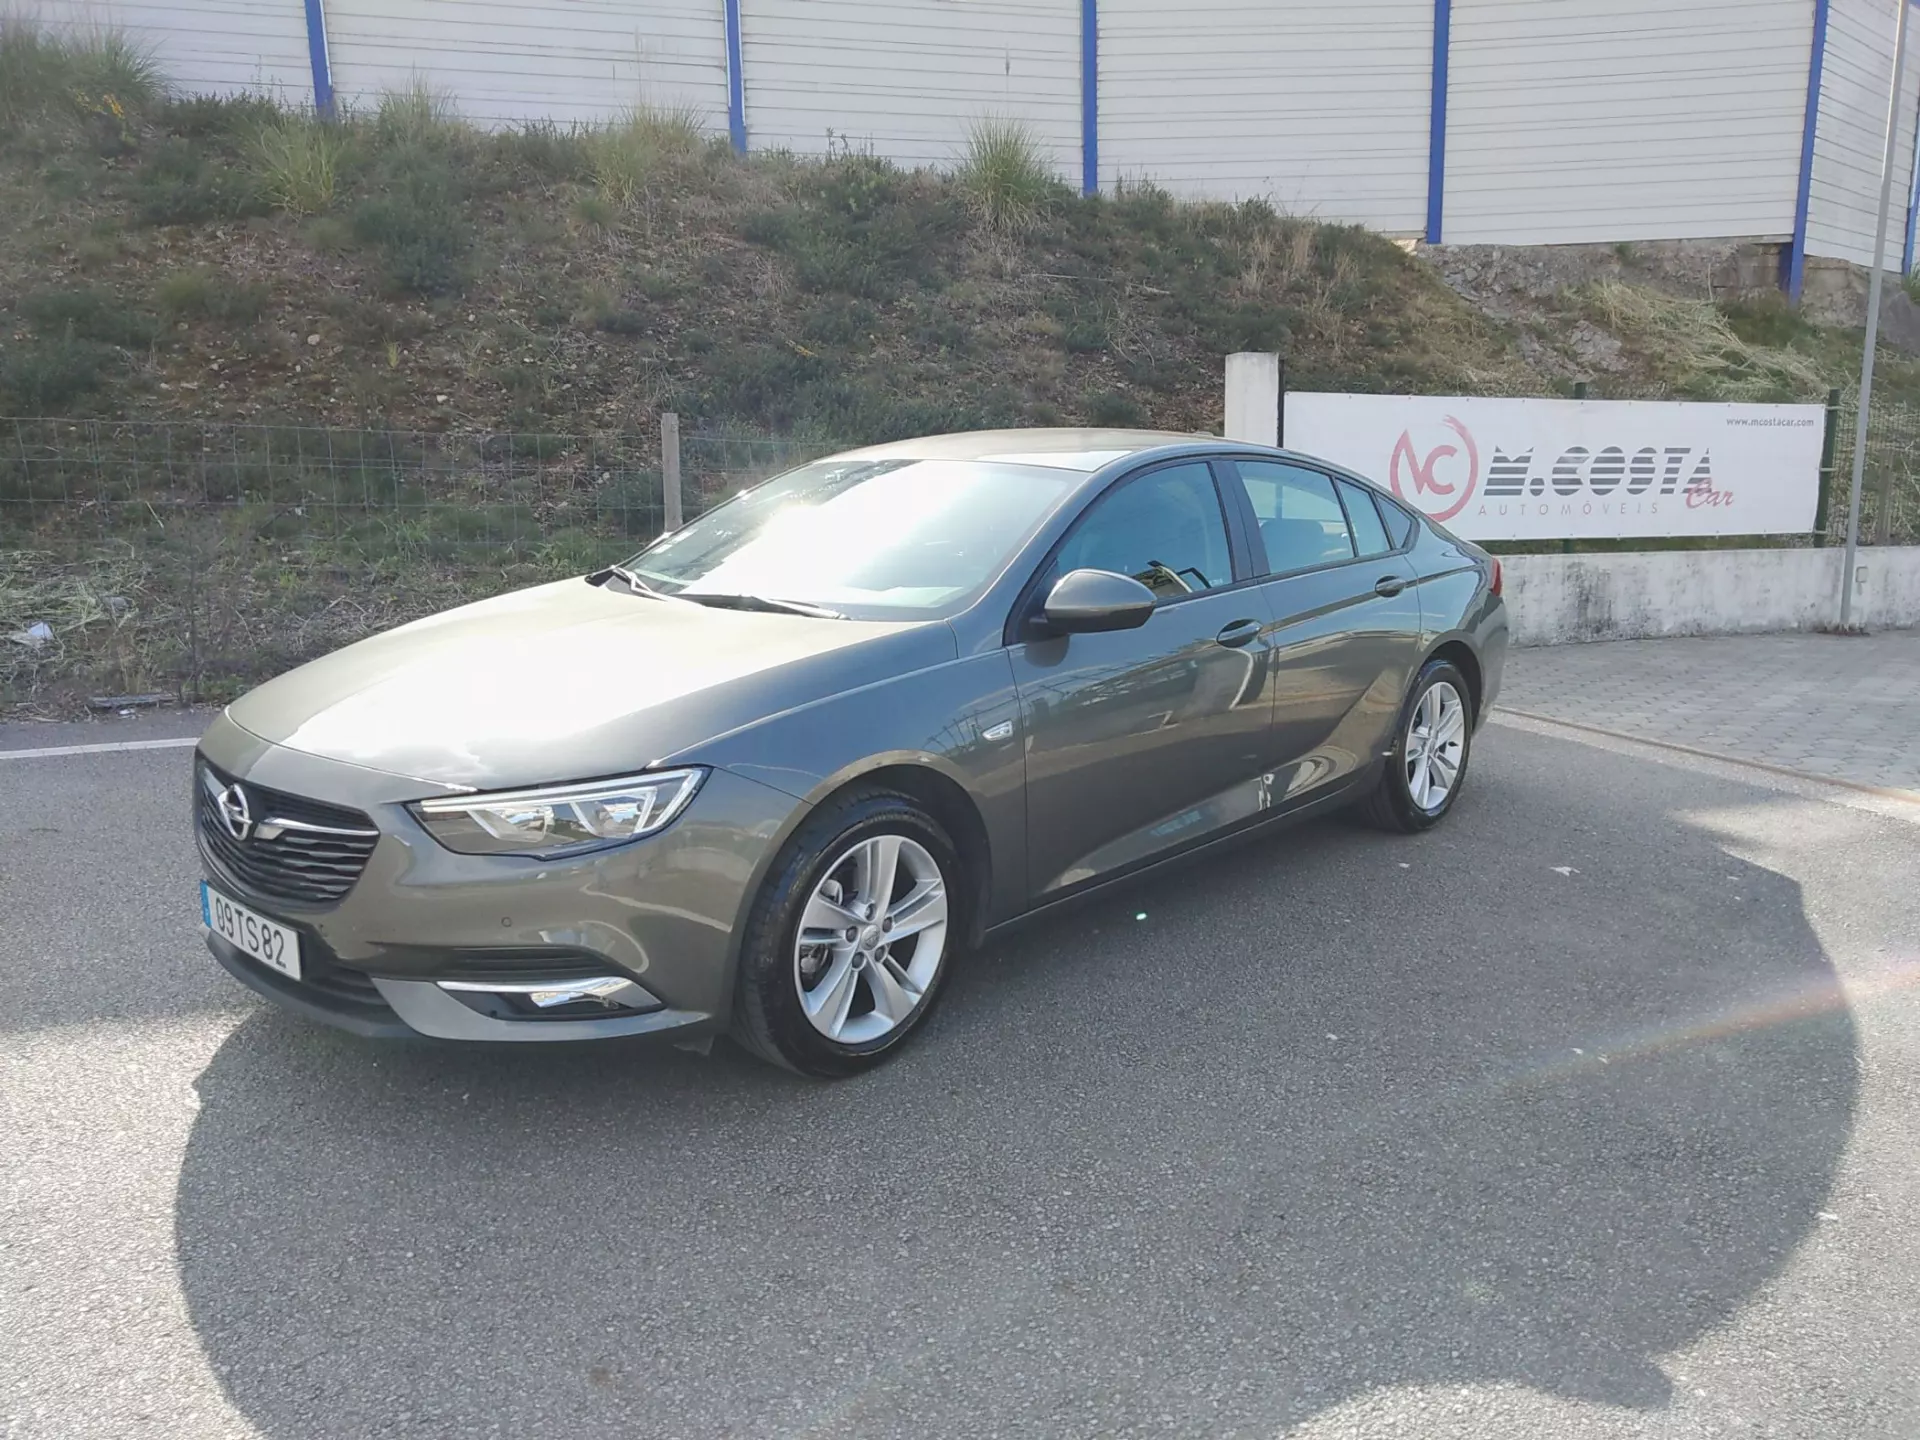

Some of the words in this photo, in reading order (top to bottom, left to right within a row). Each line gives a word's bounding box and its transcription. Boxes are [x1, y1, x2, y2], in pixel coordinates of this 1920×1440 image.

[1726, 417, 1815, 428] www.mcostacar.com
[1685, 477, 1735, 509] Car
[1477, 500, 1659, 516] AUTOMÓVEIS
